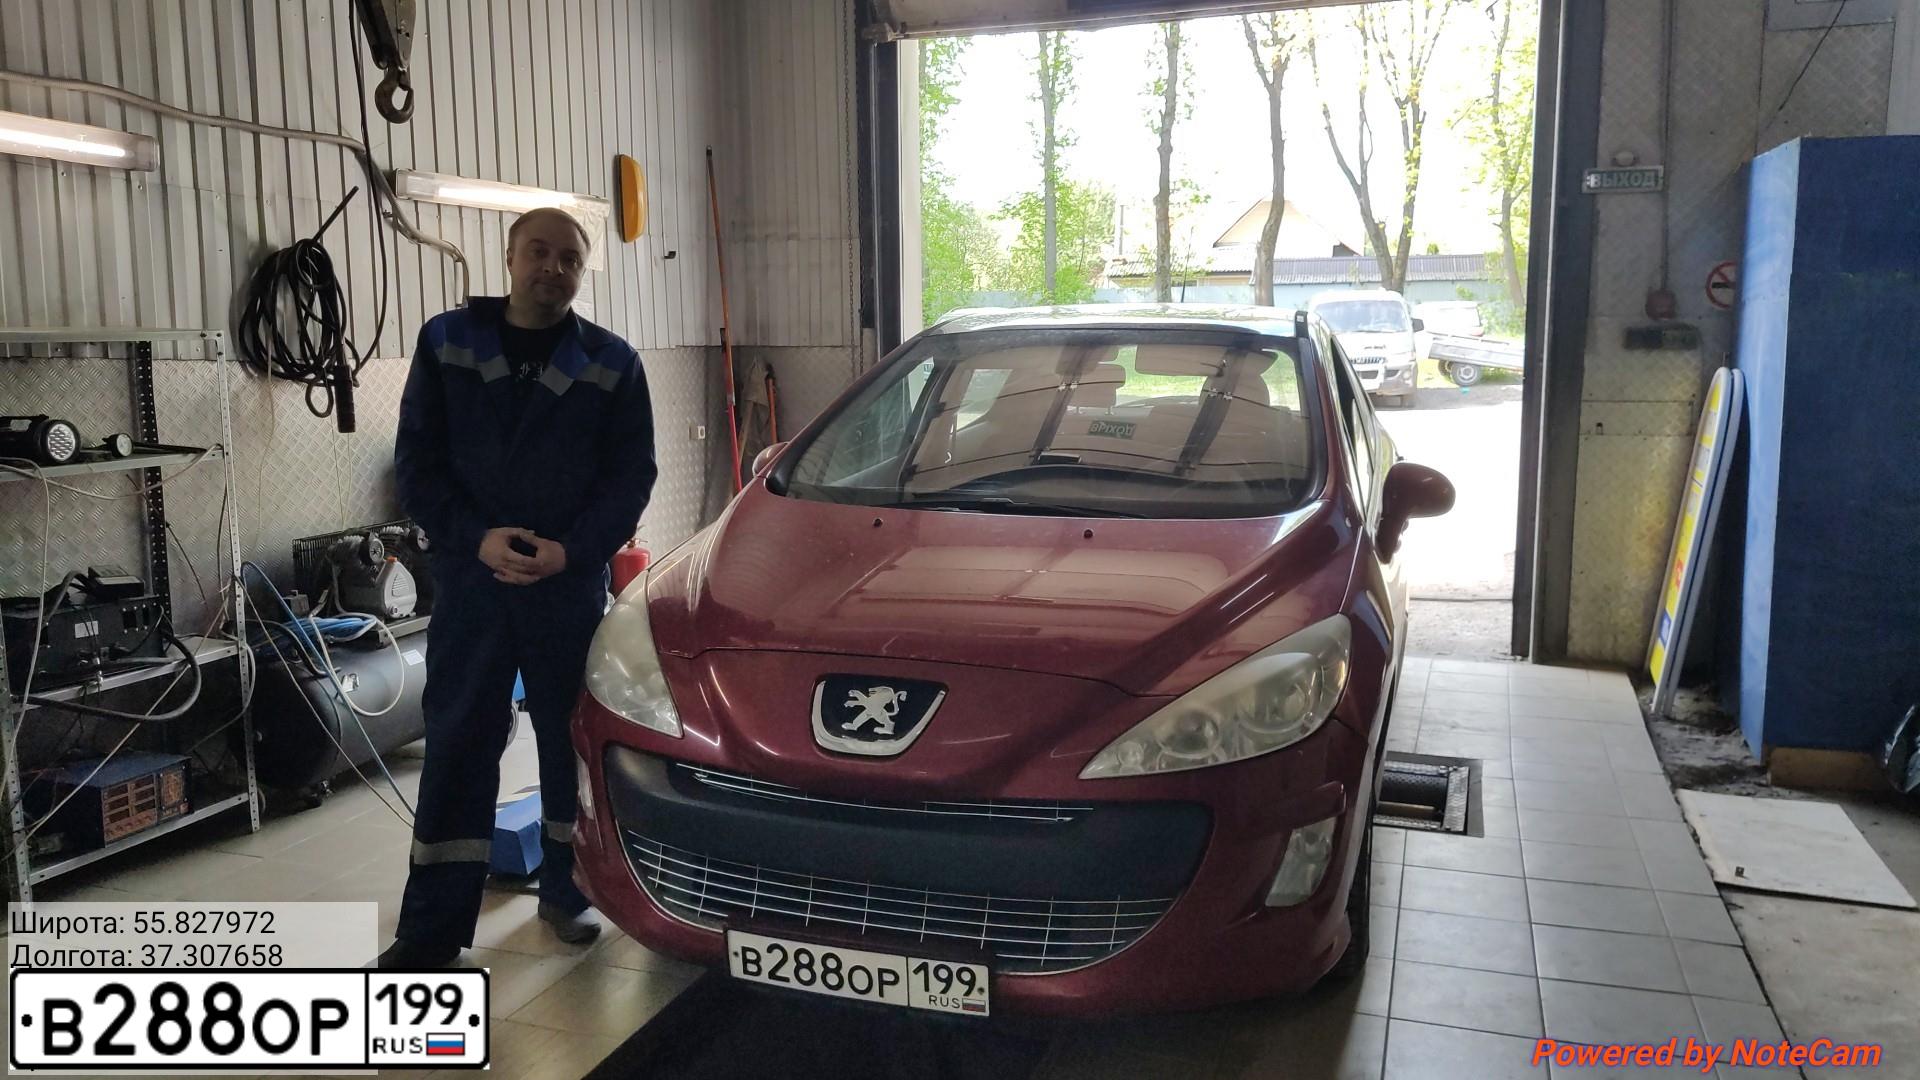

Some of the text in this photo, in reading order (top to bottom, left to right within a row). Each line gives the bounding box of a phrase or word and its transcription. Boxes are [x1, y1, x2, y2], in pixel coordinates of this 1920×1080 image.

[1590, 171, 1656, 188] ВЫХОД
[741, 942, 977, 998] В288ОР 199
[928, 994, 961, 1009] RUS
